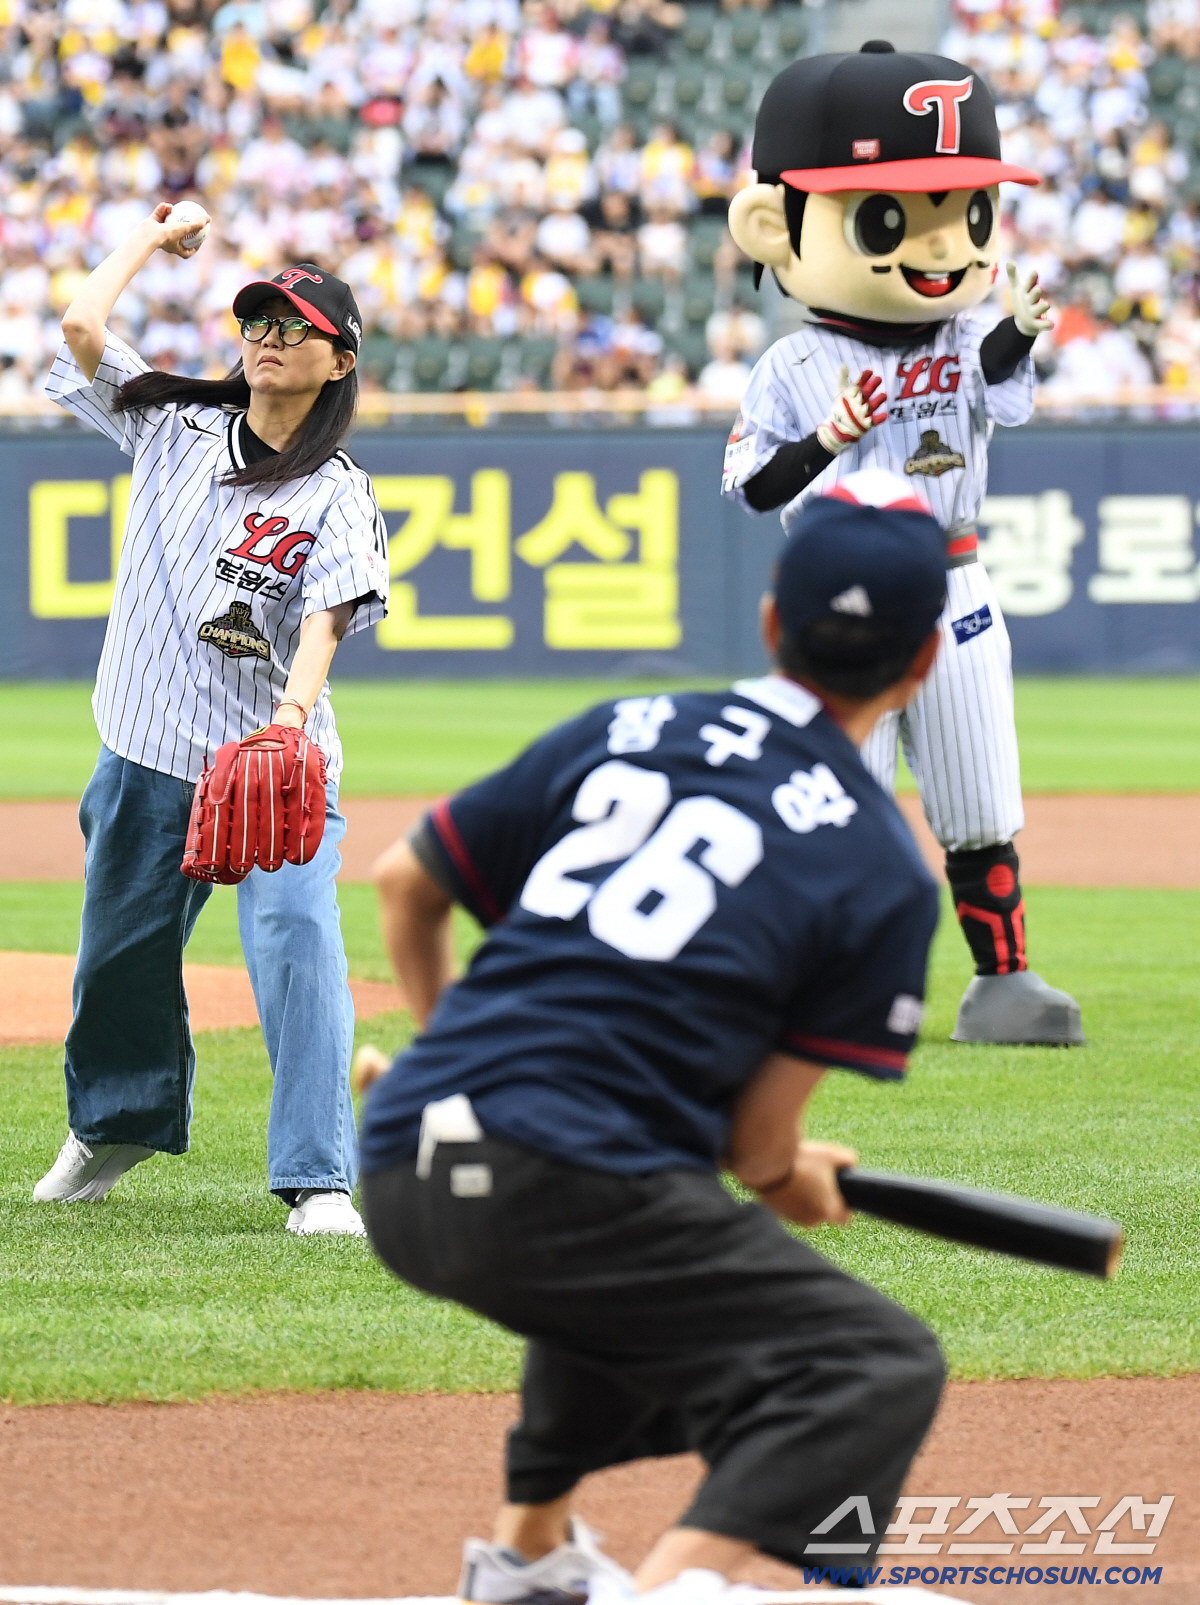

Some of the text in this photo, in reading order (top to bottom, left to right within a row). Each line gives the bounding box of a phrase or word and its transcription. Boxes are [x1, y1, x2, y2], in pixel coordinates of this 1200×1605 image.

[903, 75, 974, 154] T
[282, 268, 323, 289] T
[895, 354, 961, 401] LG
[224, 512, 317, 579] LG
[215, 556, 290, 602] 트윈스
[200, 624, 269, 656] CHAMPIONS
[519, 757, 764, 963] 26
